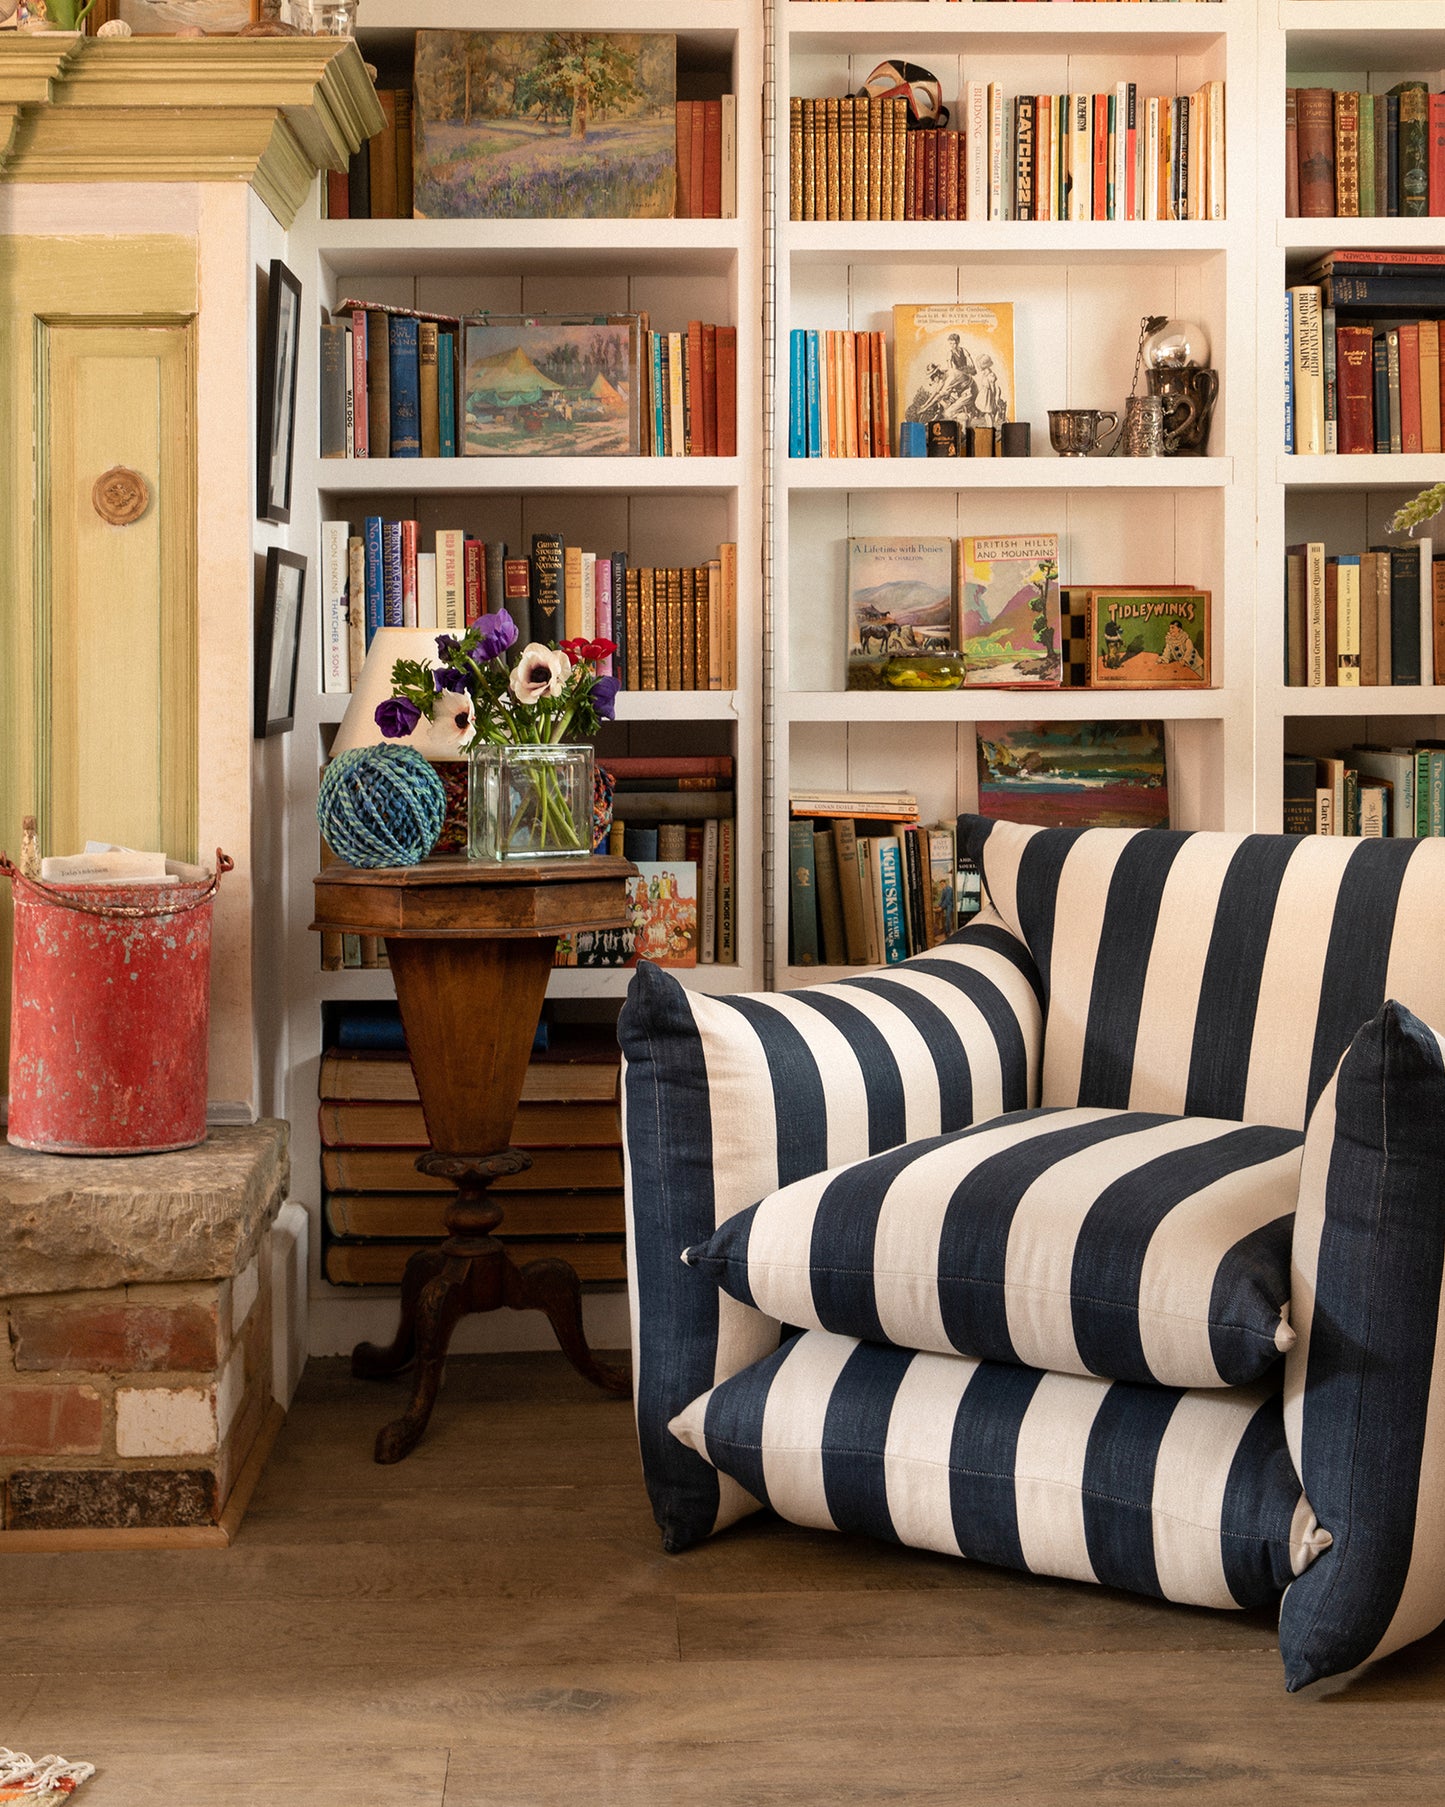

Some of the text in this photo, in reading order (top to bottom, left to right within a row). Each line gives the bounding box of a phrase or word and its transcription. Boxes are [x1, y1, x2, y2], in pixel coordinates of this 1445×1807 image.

[974, 87, 982, 139] BIRDSONG
[1077, 96, 1087, 132] SOLZHENITSYN
[1018, 104, 1032, 202] CATCH-22
[1343, 252, 1445, 263] YSICAL FITNESS FOR WOMEN
[356, 335, 364, 360] Secret
[390, 329, 411, 338] OWL
[1299, 293, 1310, 372] BIRD OF PARADISE
[1309, 293, 1319, 377] DIANA STAINFORTH
[356, 360, 364, 394] beaches
[330, 528, 338, 558] SIMON
[536, 541, 560, 550] GREAT
[547, 554, 560, 562] ALL
[853, 544, 944, 553] A Lifetime with Ponies
[976, 539, 1055, 550] BRITISH HILLS
[976, 548, 1054, 559] AND MOUNTAINS
[331, 559, 339, 594] JENKINS
[367, 522, 380, 628] No Ordinary Tourist
[383, 524, 393, 624] BEYOND JULES VERNE
[391, 524, 402, 625] ROBIN KNOX-JOHNSTON
[445, 558, 456, 587] PARADISE
[535, 561, 563, 570] NATIONS
[467, 546, 479, 619] Embracing Uncertainty
[583, 571, 591, 599] MORRIS
[446, 590, 456, 608] DIANA
[615, 583, 623, 617] DUNMORE
[1107, 601, 1195, 623] TIDLEYWINKS
[331, 598, 339, 643] THATCHER
[1311, 557, 1322, 685] Graham Greene Monsignor Quixote
[1418, 753, 1429, 785] THE
[1433, 761, 1442, 779] The
[1403, 769, 1413, 810] Samplers
[1431, 780, 1442, 825] Complete
[1321, 797, 1331, 836] Clare Fra
[708, 825, 716, 852] Levels
[707, 864, 715, 881] Life
[708, 853, 715, 862] of
[882, 842, 898, 917] NIGHT SKY
[706, 885, 715, 913] Julian
[723, 921, 730, 931] OF
[887, 916, 895, 947] FRANCIS
